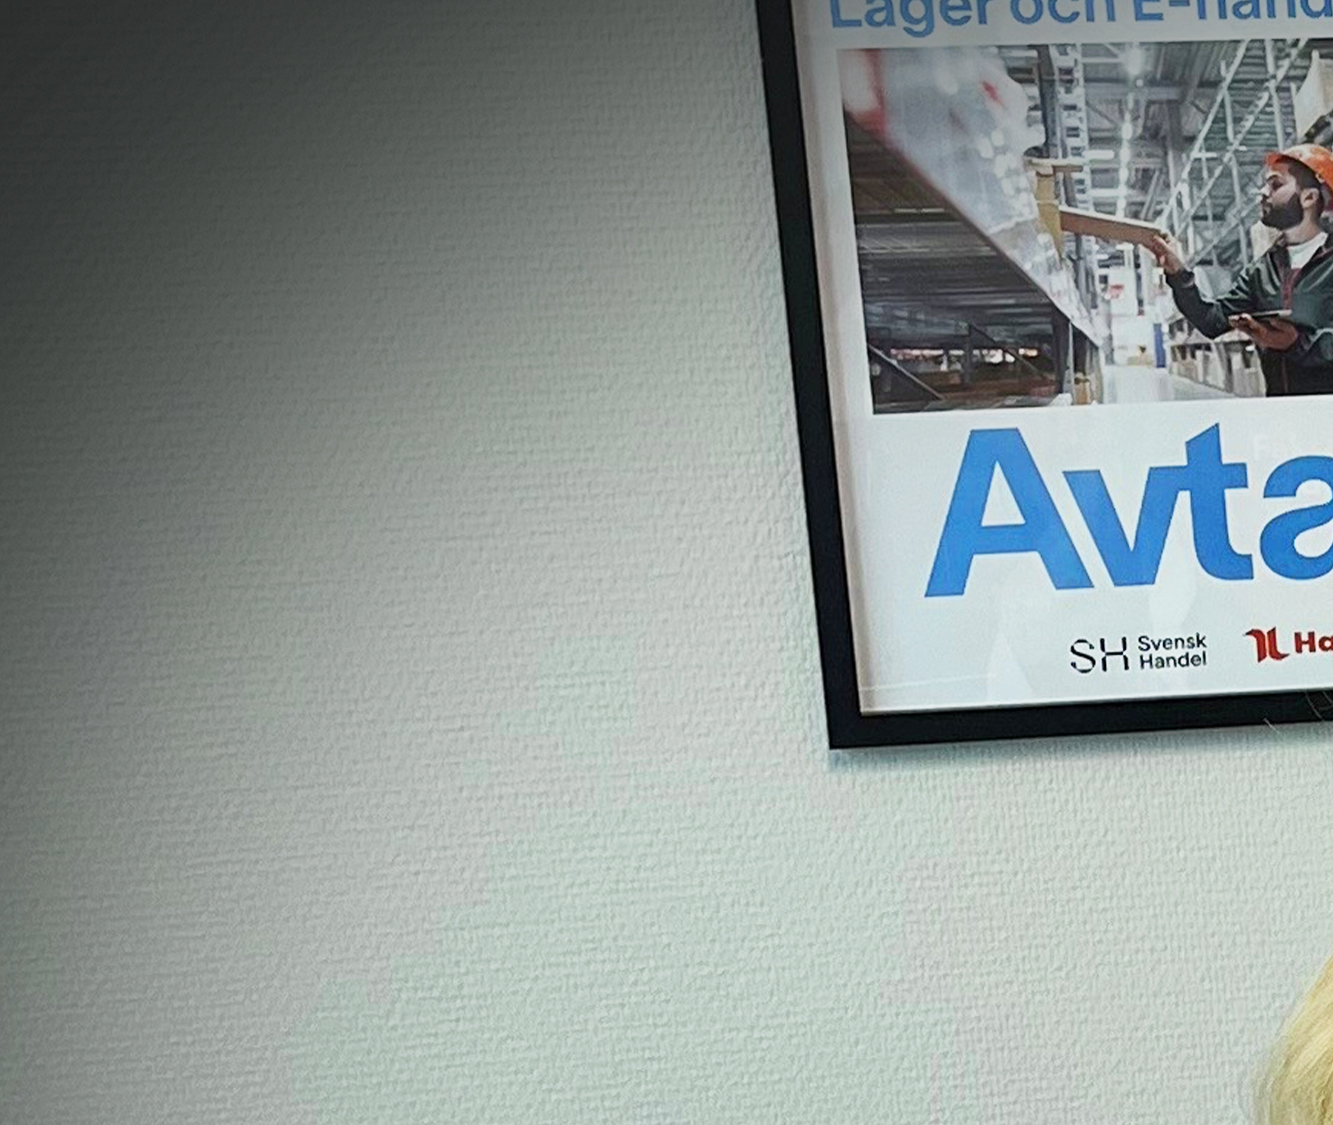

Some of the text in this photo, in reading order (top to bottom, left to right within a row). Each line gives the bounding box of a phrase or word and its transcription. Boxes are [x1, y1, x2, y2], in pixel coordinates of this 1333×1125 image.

[1138, 632, 1207, 651] Svensk
[1070, 636, 1129, 674] SH
[1140, 650, 1207, 669] Handel
